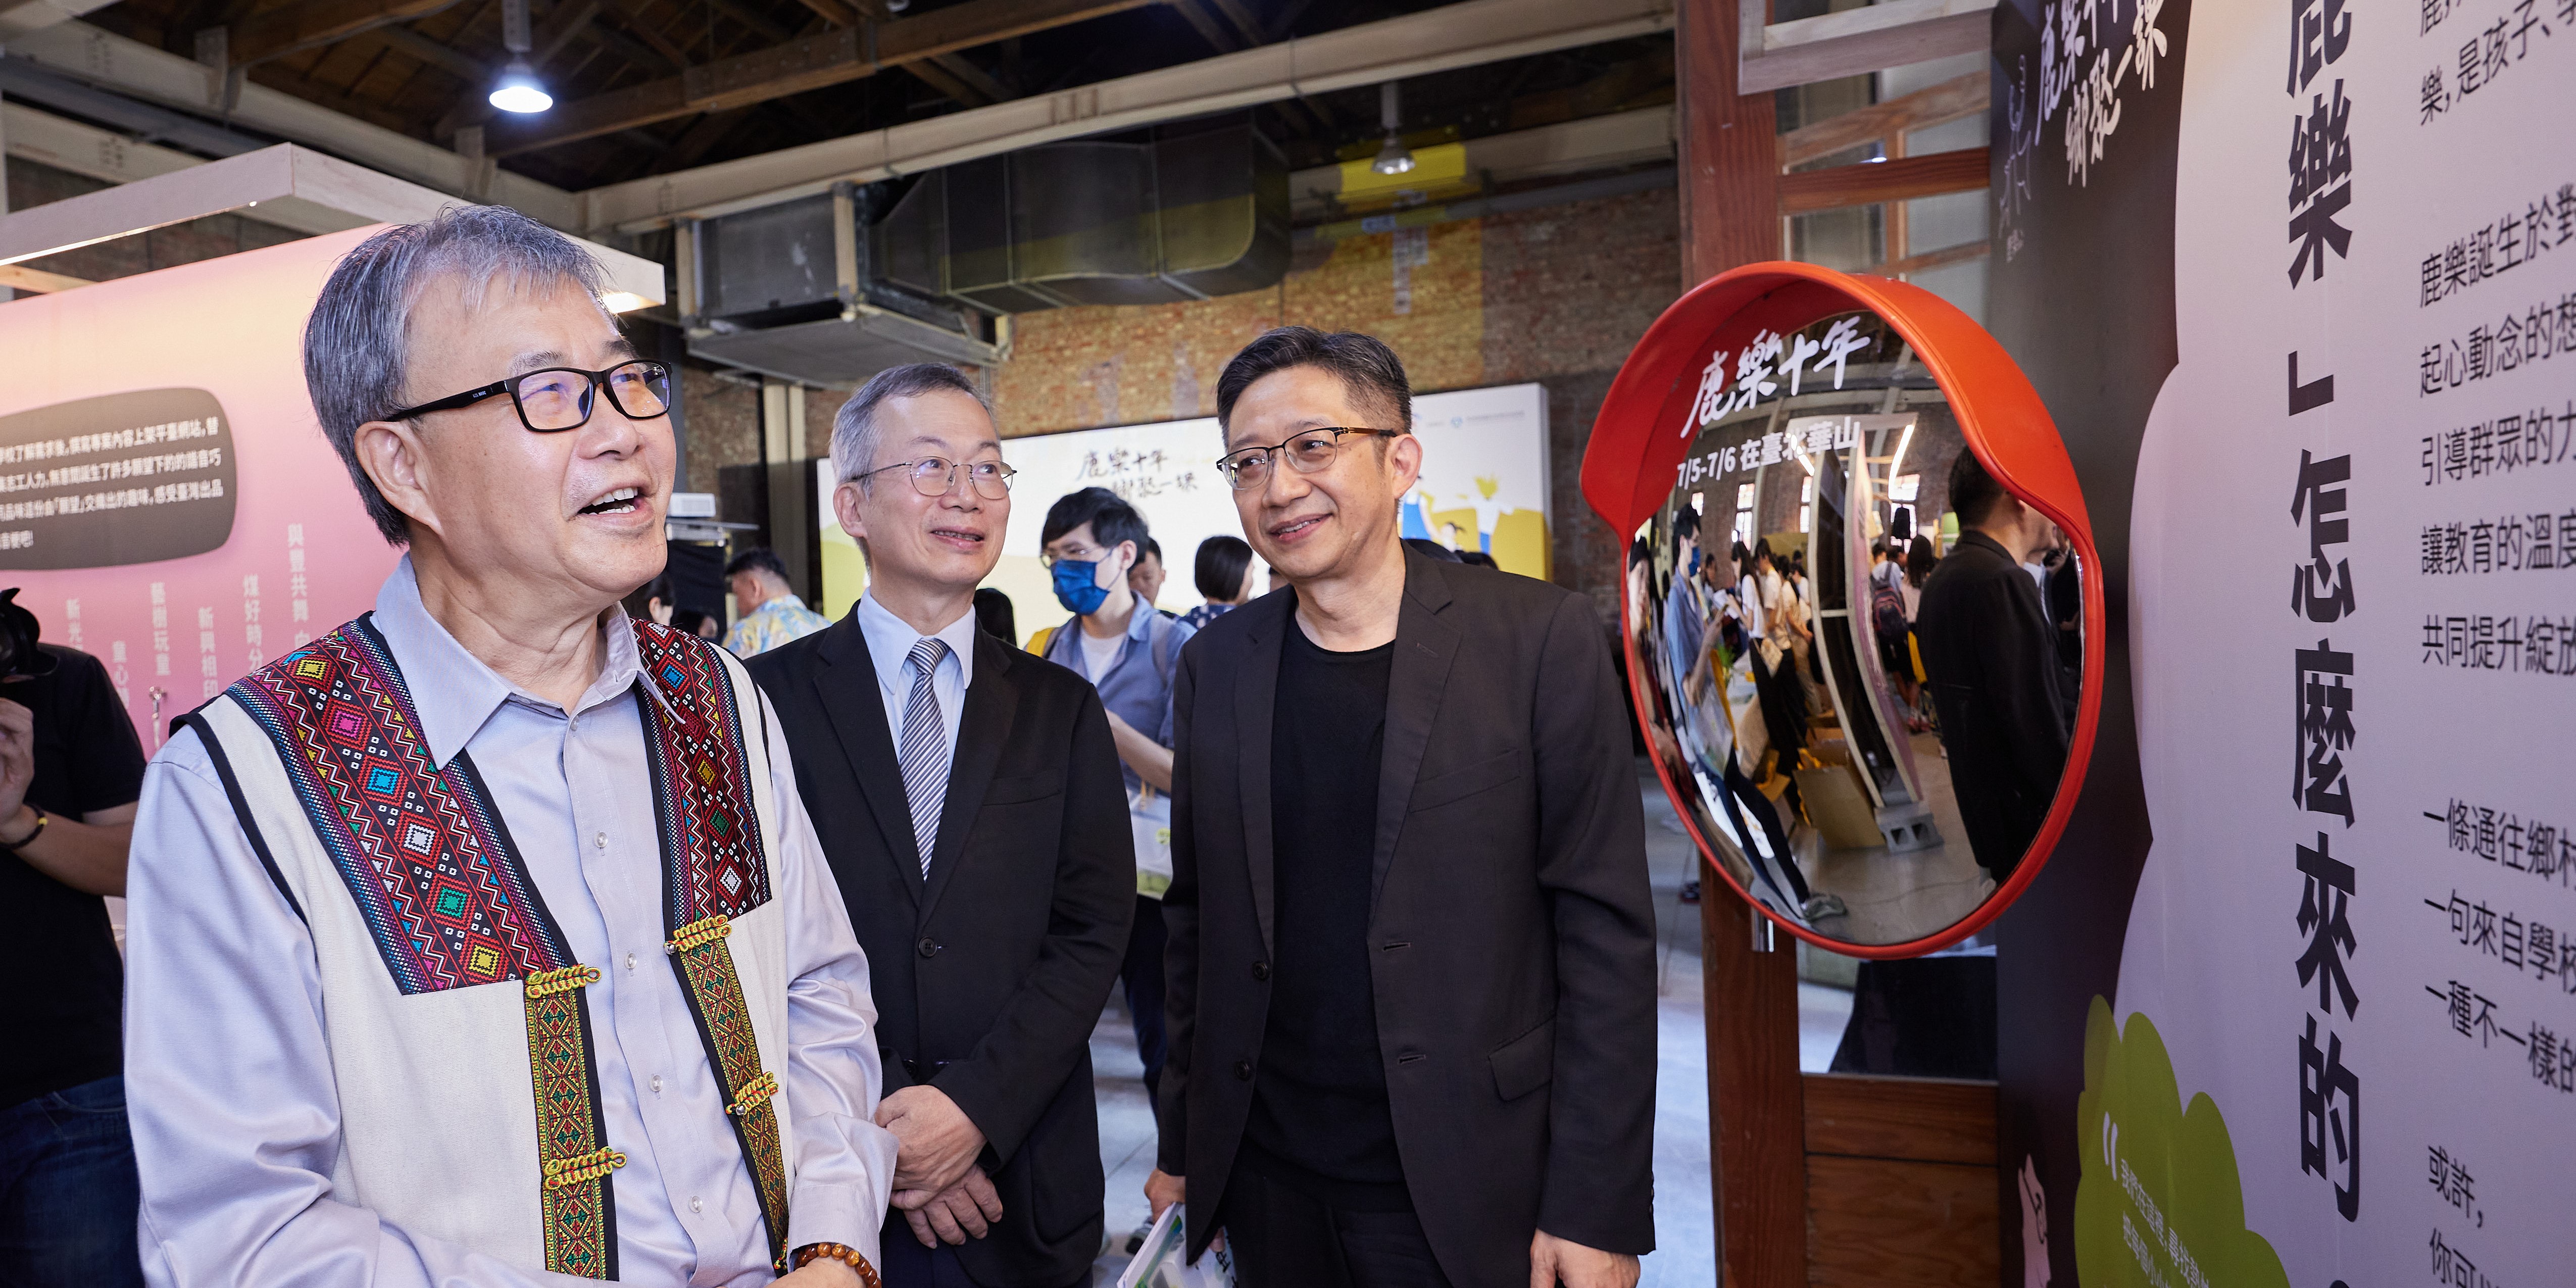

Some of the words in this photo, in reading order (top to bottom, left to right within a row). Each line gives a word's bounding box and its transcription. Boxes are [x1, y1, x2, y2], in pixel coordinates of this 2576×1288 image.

[2035, 0, 2118, 146] 鹿樂
[1680, 316, 1870, 438] 鹿樂十年
[1677, 447, 1736, 490] 7/5-7/6
[1740, 416, 1861, 471] 在臺北華山
[2287, 0, 2359, 1288] 樂」怎麼來的
[2430, 1228, 2498, 1288] 你可
